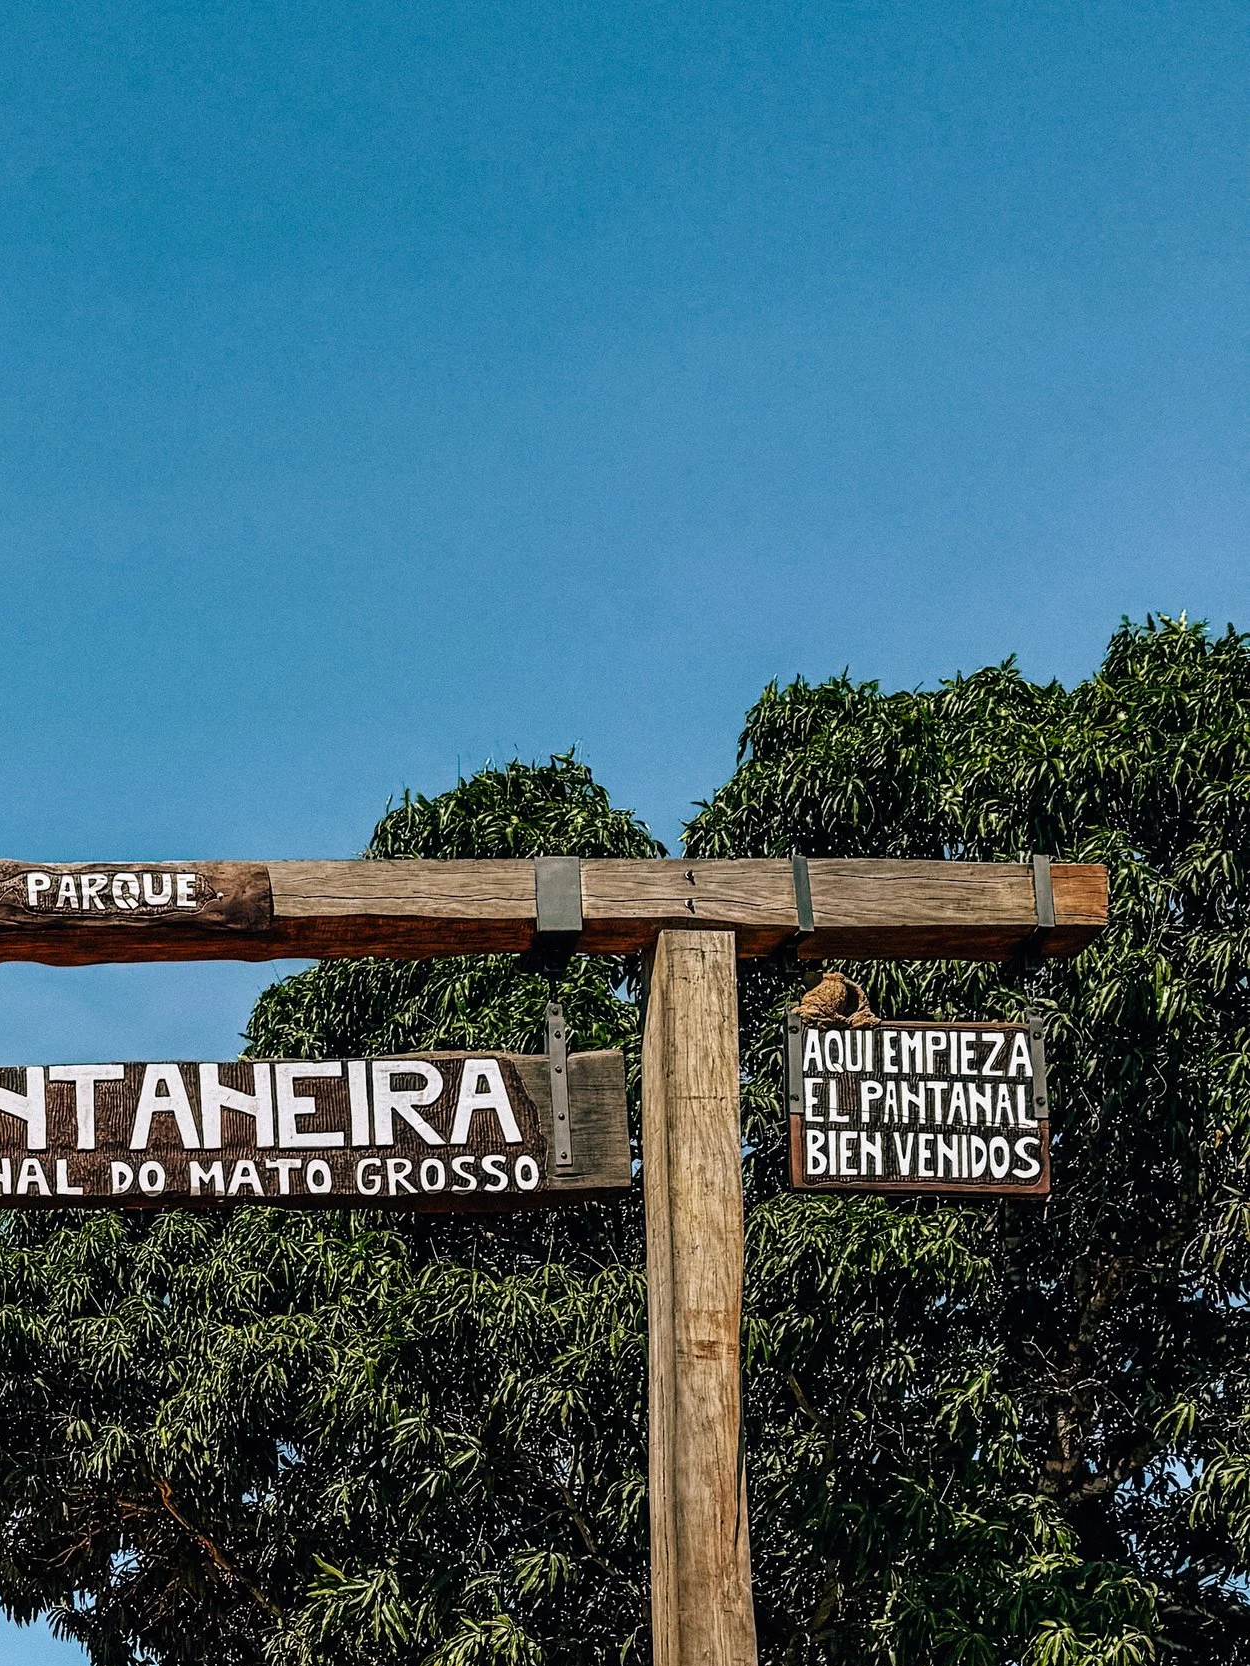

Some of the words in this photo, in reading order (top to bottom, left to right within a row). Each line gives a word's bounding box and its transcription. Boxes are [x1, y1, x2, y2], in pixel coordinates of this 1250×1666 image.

[27, 870, 197, 910] PARQUE
[802, 1028, 873, 1074] AQUI
[883, 1030, 1034, 1077] EMPIEZA
[804, 1077, 850, 1123] EL
[859, 1079, 1038, 1129] PANTANAL
[110, 1160, 166, 1195] DO
[189, 1158, 333, 1197] MATO
[356, 1154, 540, 1196] GROSSO
[806, 1129, 883, 1176] BIEN
[893, 1131, 1041, 1179] VENIDOS
